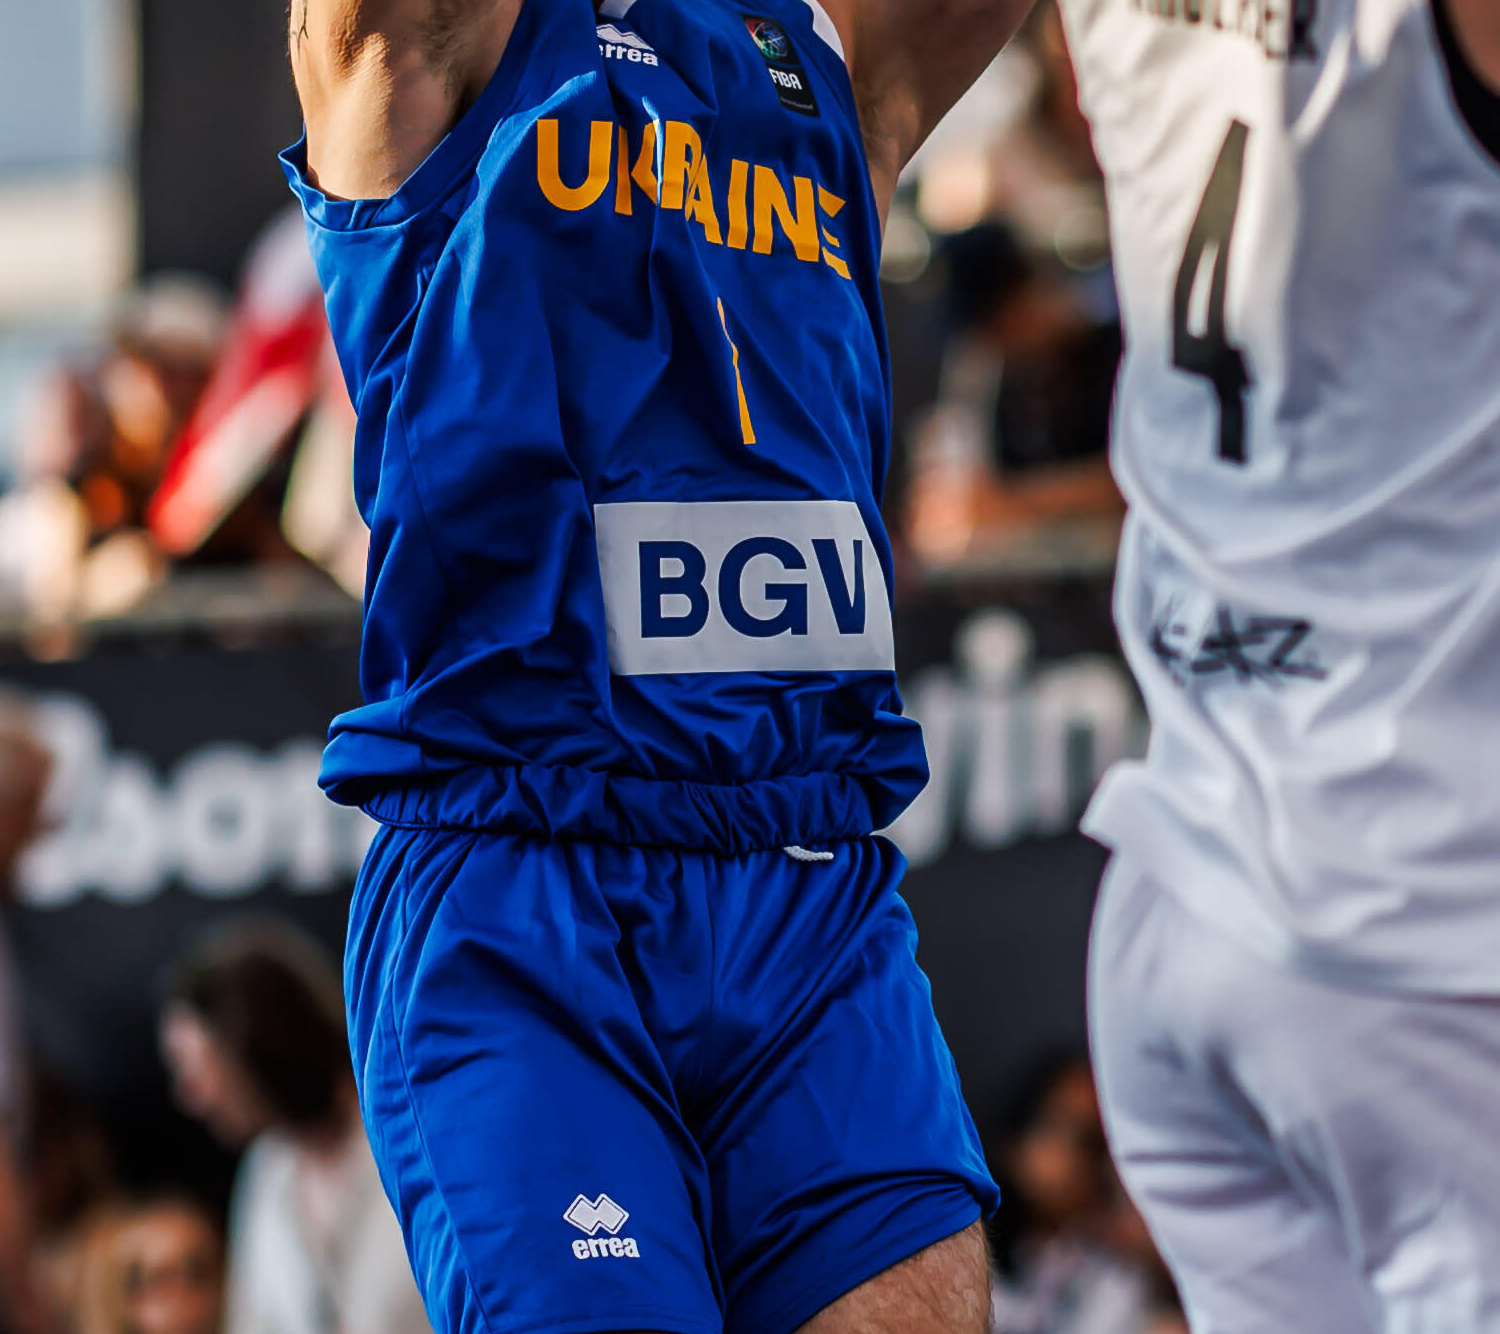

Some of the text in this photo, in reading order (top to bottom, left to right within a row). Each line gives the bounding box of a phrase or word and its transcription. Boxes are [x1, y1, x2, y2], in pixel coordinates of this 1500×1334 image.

[768, 68, 803, 90] FIBA
[536, 118, 852, 281] UKRAINE
[1171, 118, 1255, 466] 4
[639, 536, 868, 640] BGV
[571, 1237, 641, 1260] errea
